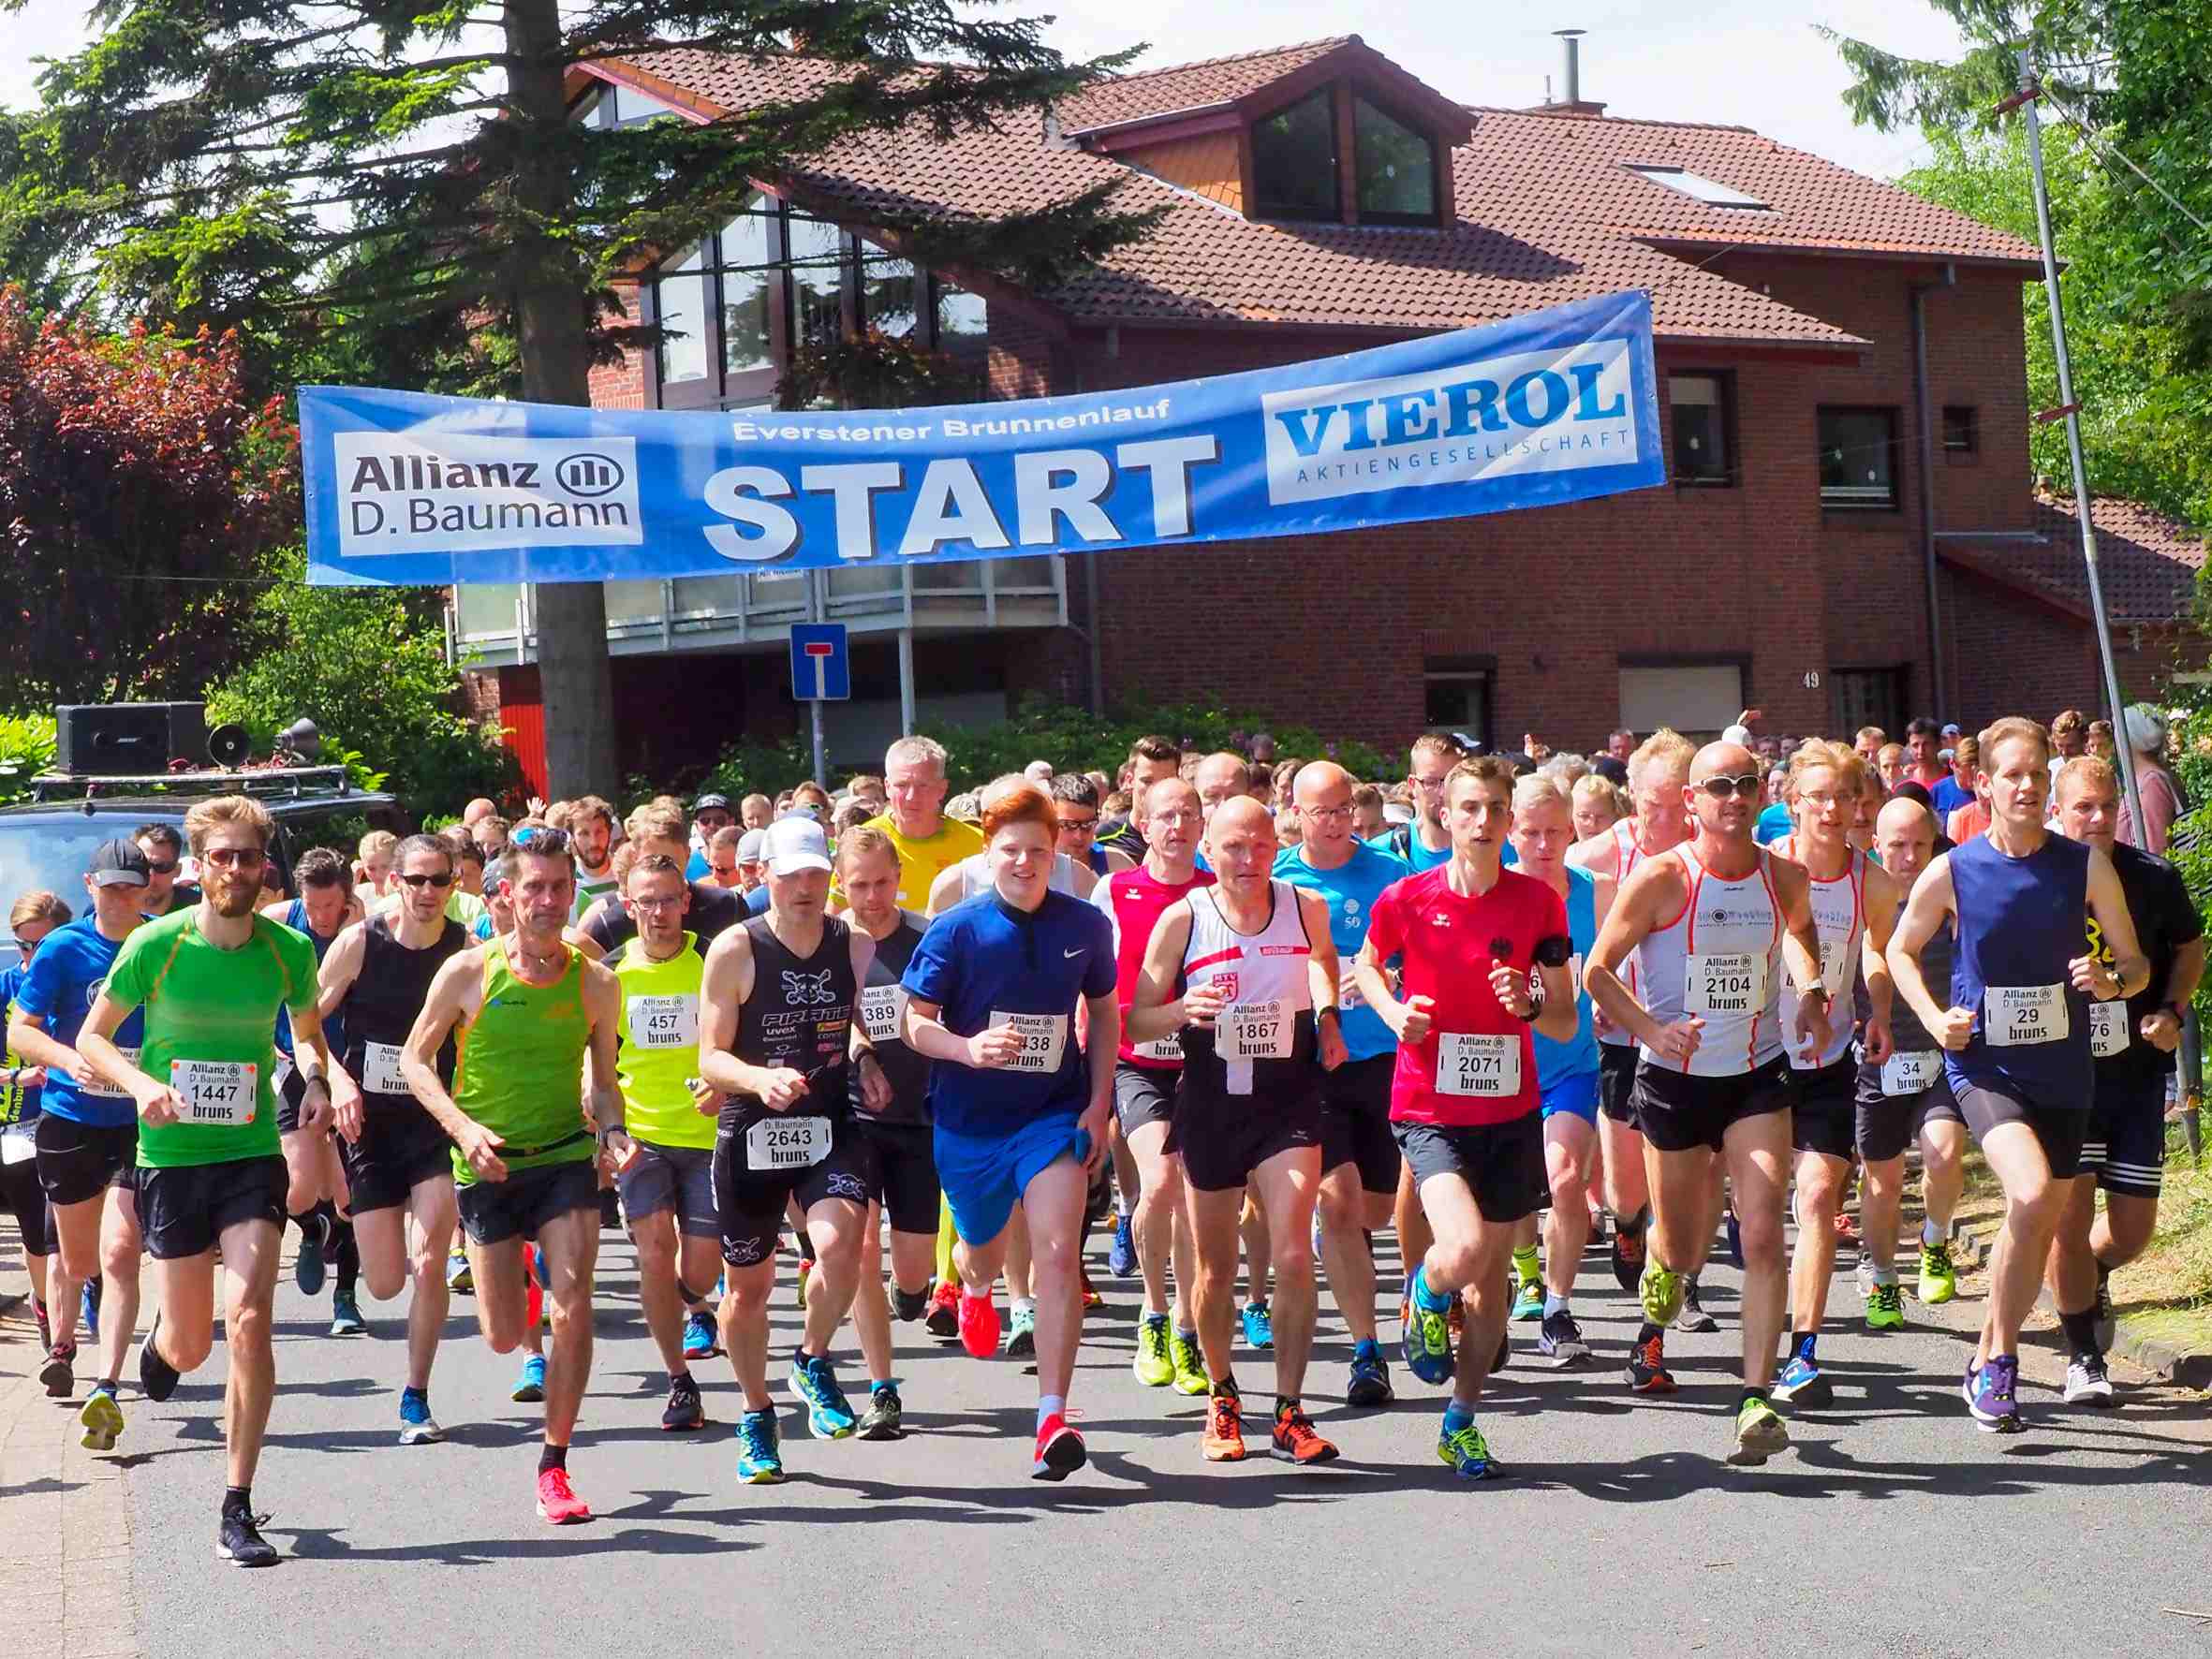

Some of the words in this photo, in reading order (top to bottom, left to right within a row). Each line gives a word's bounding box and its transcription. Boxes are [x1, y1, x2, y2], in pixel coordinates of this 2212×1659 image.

[1275, 362, 1627, 457] VIEROL
[733, 422, 931, 442] Everstener
[943, 399, 1170, 437] Brunnenlauf
[1297, 430, 1629, 483] AKTIENGESELLSCHAFT
[350, 455, 540, 493] Allianz
[702, 434, 1217, 562] START
[1705, 959, 1738, 967] Allianz
[1705, 976, 1751, 993] 2104
[1708, 994, 1747, 1009] bruns
[2003, 990, 2038, 999] Allianz
[865, 1006, 895, 1021] 389
[1233, 1005, 1266, 1014] Allianz
[2017, 1008, 2039, 1023] 29
[649, 1015, 677, 1029] 457
[868, 1024, 894, 1035] runs
[647, 1030, 682, 1044] bruns
[766, 1026, 796, 1035] uvex
[1236, 1022, 1279, 1039] 1867
[2009, 1025, 2047, 1040] bruns
[2090, 1023, 2110, 1037] 76
[1019, 1035, 1050, 1050] 438
[1239, 1041, 1277, 1055] bruns
[1458, 1036, 1492, 1046] Allianz
[190, 1064, 226, 1074] Allianz
[1458, 1057, 1501, 1073] 2071
[1903, 1062, 1920, 1075] 34
[382, 1077, 409, 1090] brun
[1461, 1074, 1499, 1090] bruns
[192, 1084, 238, 1101] 1447
[193, 1102, 232, 1119] bruns
[767, 1130, 812, 1147] 2643
[772, 1148, 810, 1163] bruns
